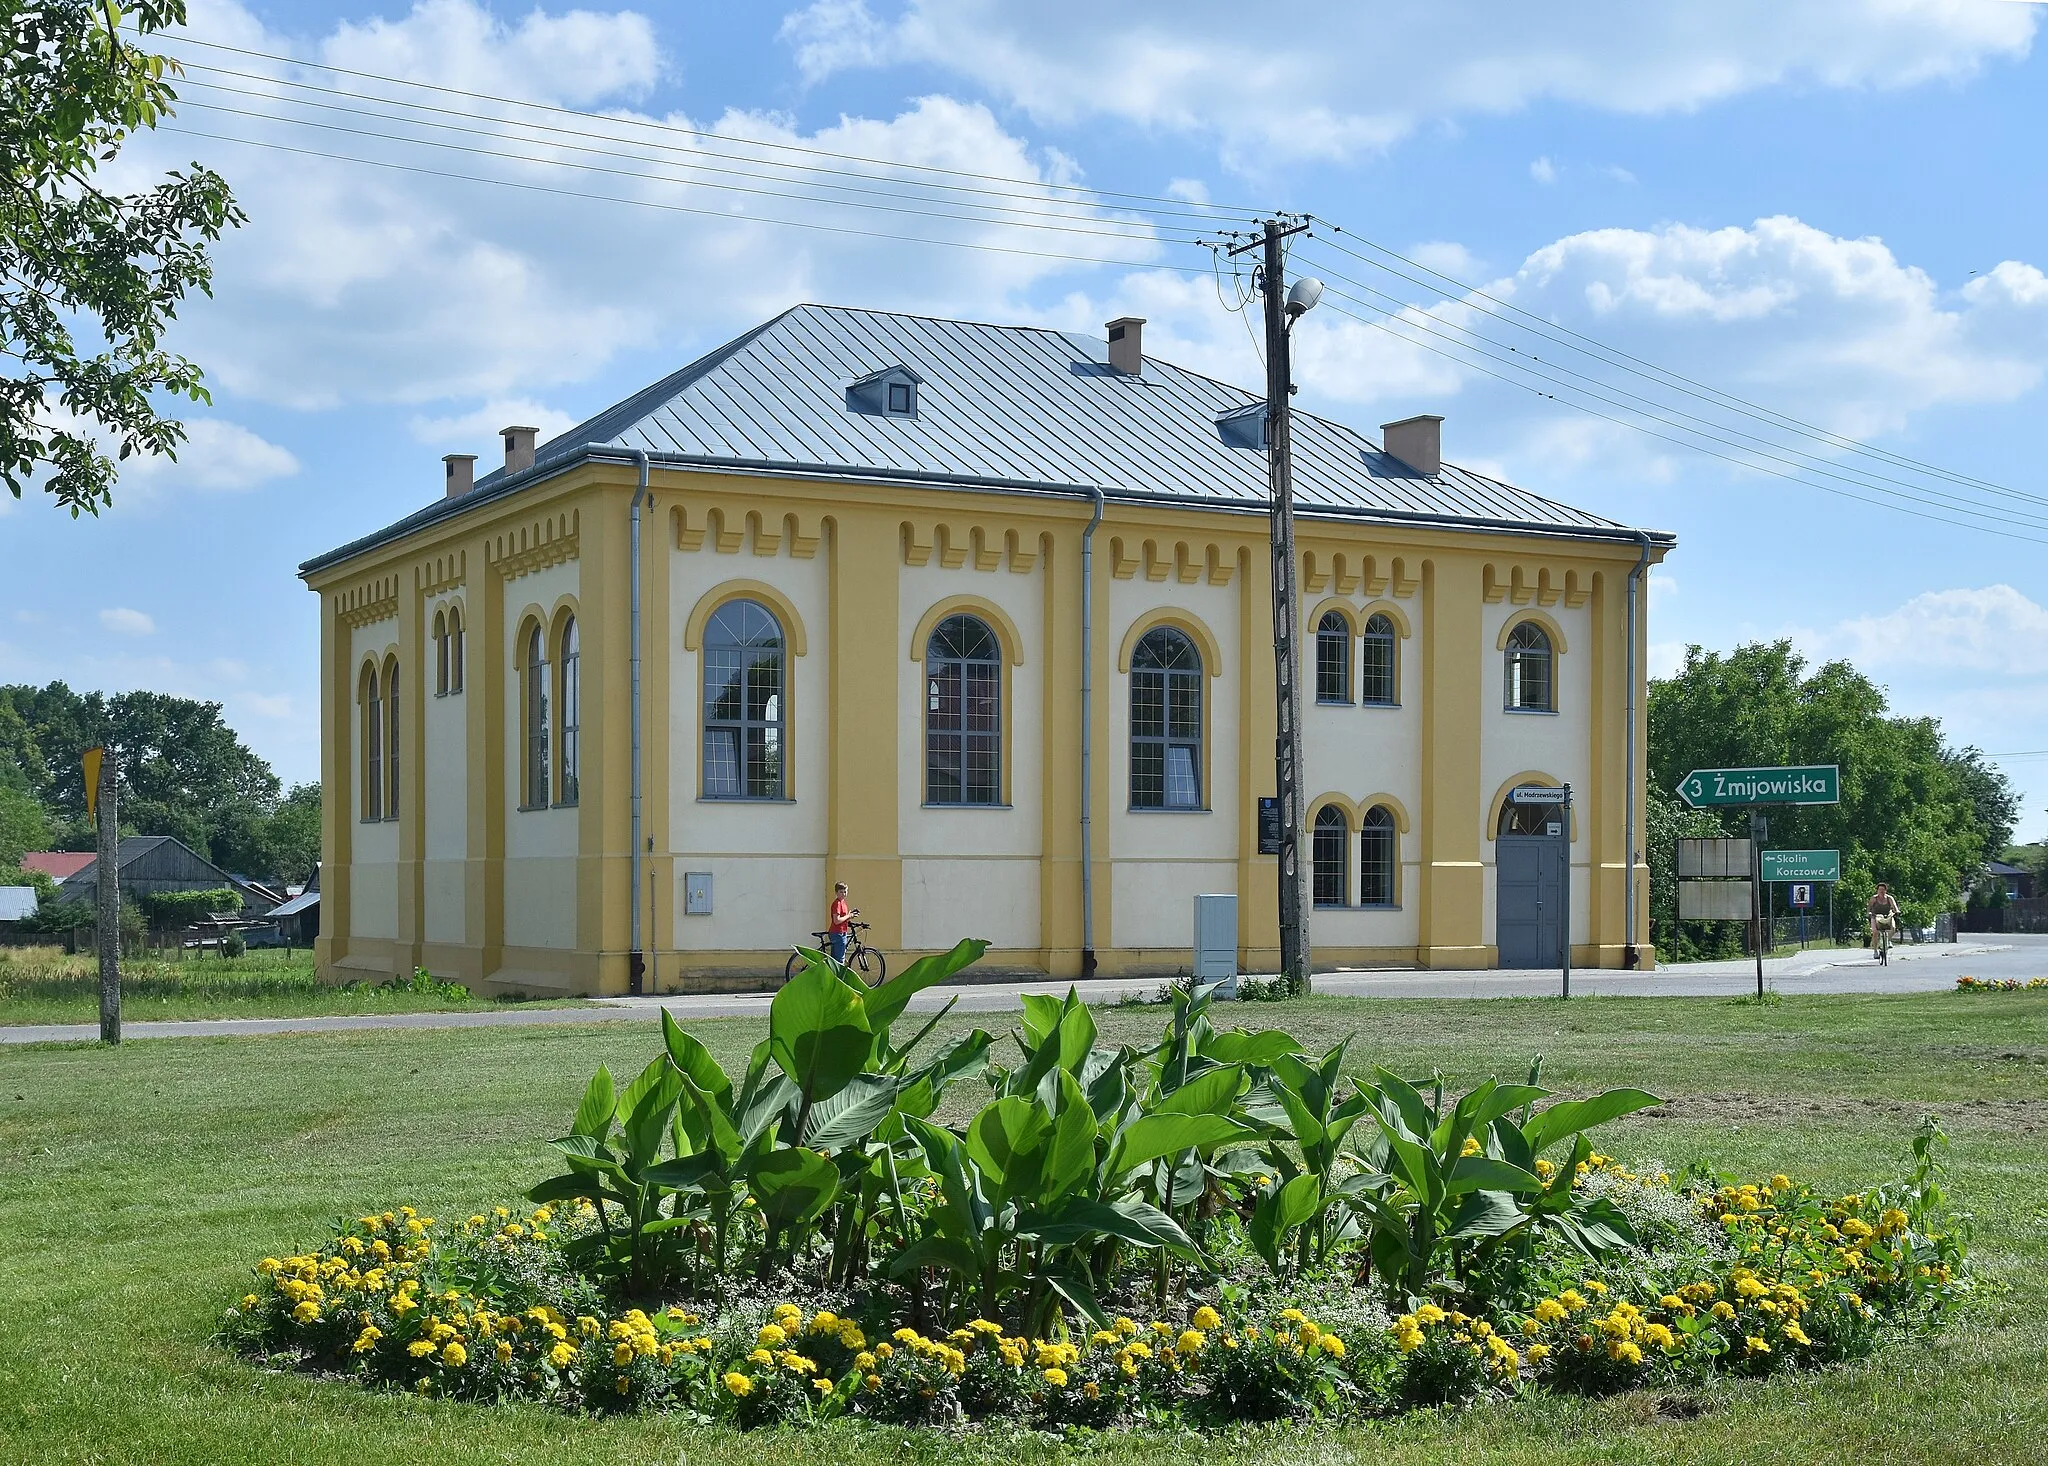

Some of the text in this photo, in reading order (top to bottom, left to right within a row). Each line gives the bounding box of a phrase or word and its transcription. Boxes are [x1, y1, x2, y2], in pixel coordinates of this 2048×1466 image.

[1690, 773, 1826, 801] 3 Żmijowiska
[1776, 854, 1808, 864] Skolin
[1776, 867, 1825, 876] Korczowa
